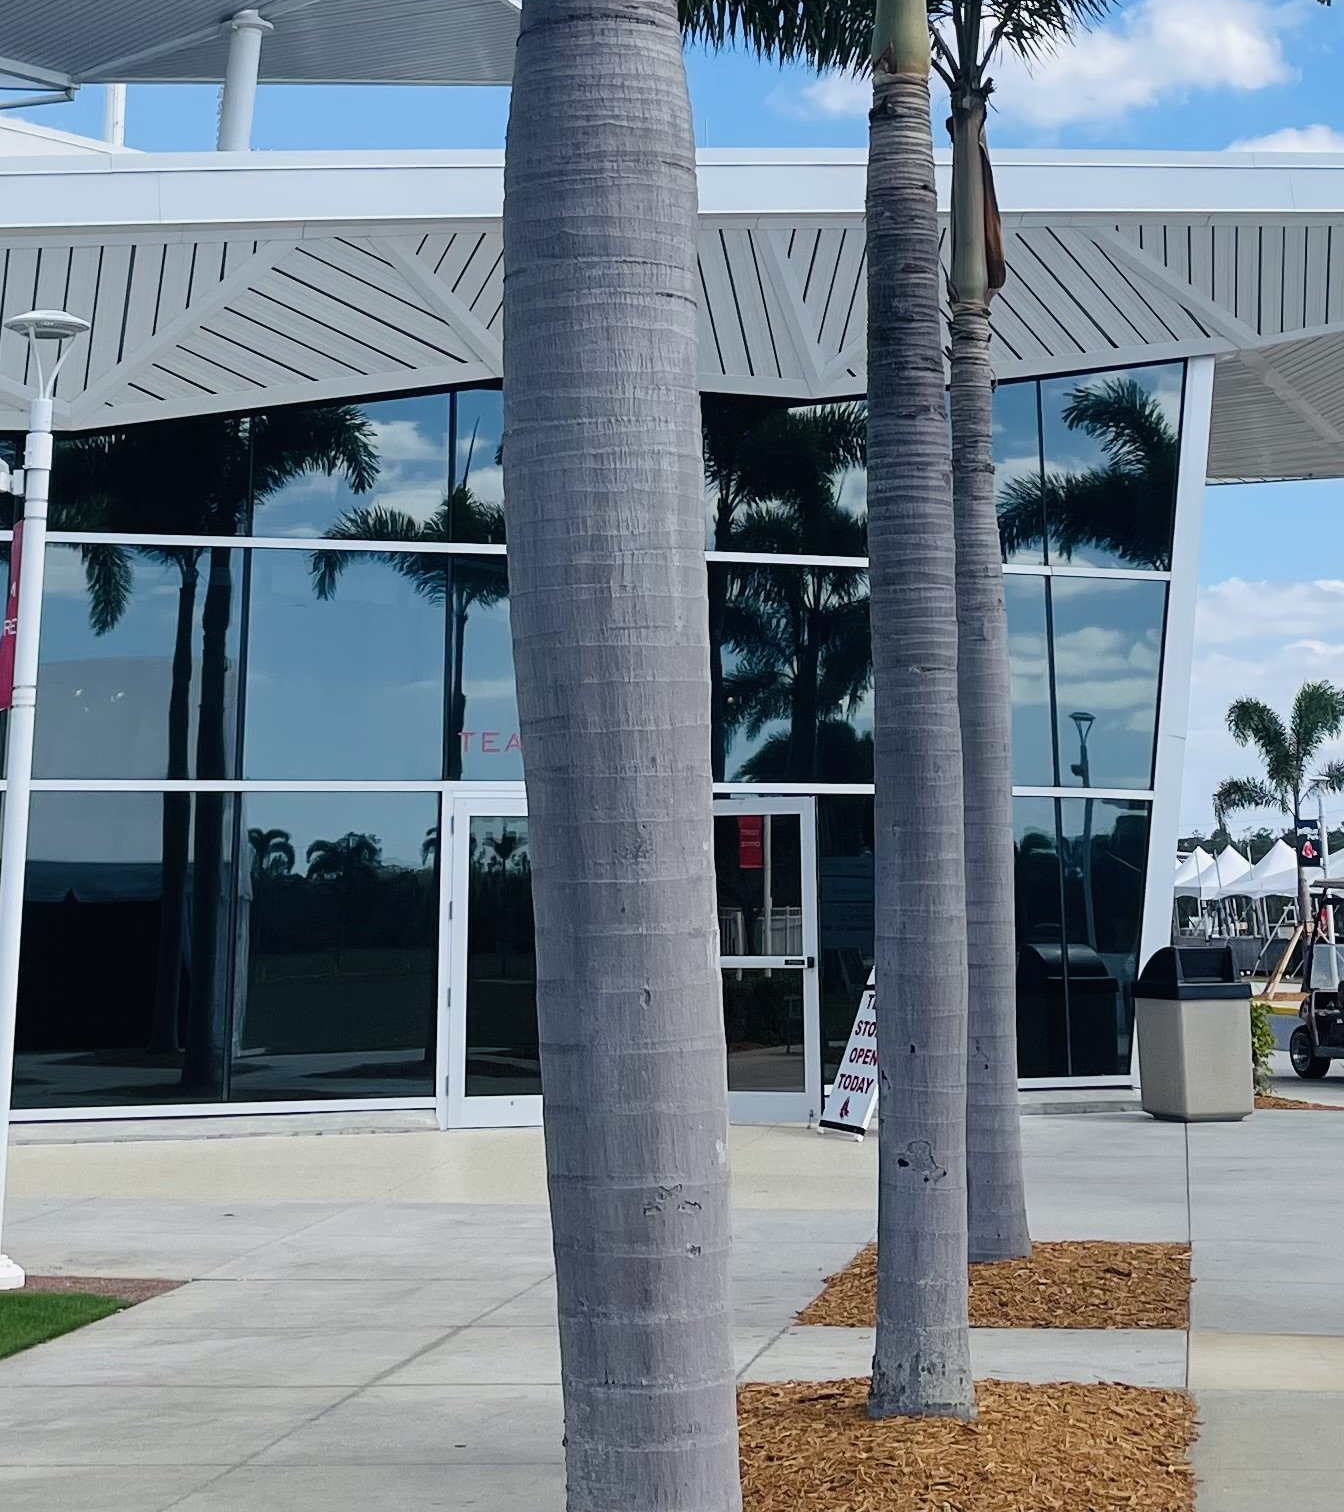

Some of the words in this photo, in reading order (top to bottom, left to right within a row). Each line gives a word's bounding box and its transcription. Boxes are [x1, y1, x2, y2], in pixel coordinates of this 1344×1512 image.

[457, 732, 522, 753] TEA
[855, 1020, 877, 1038] STO
[849, 1047, 879, 1066] OPEN
[838, 1073, 874, 1094] TODAY
